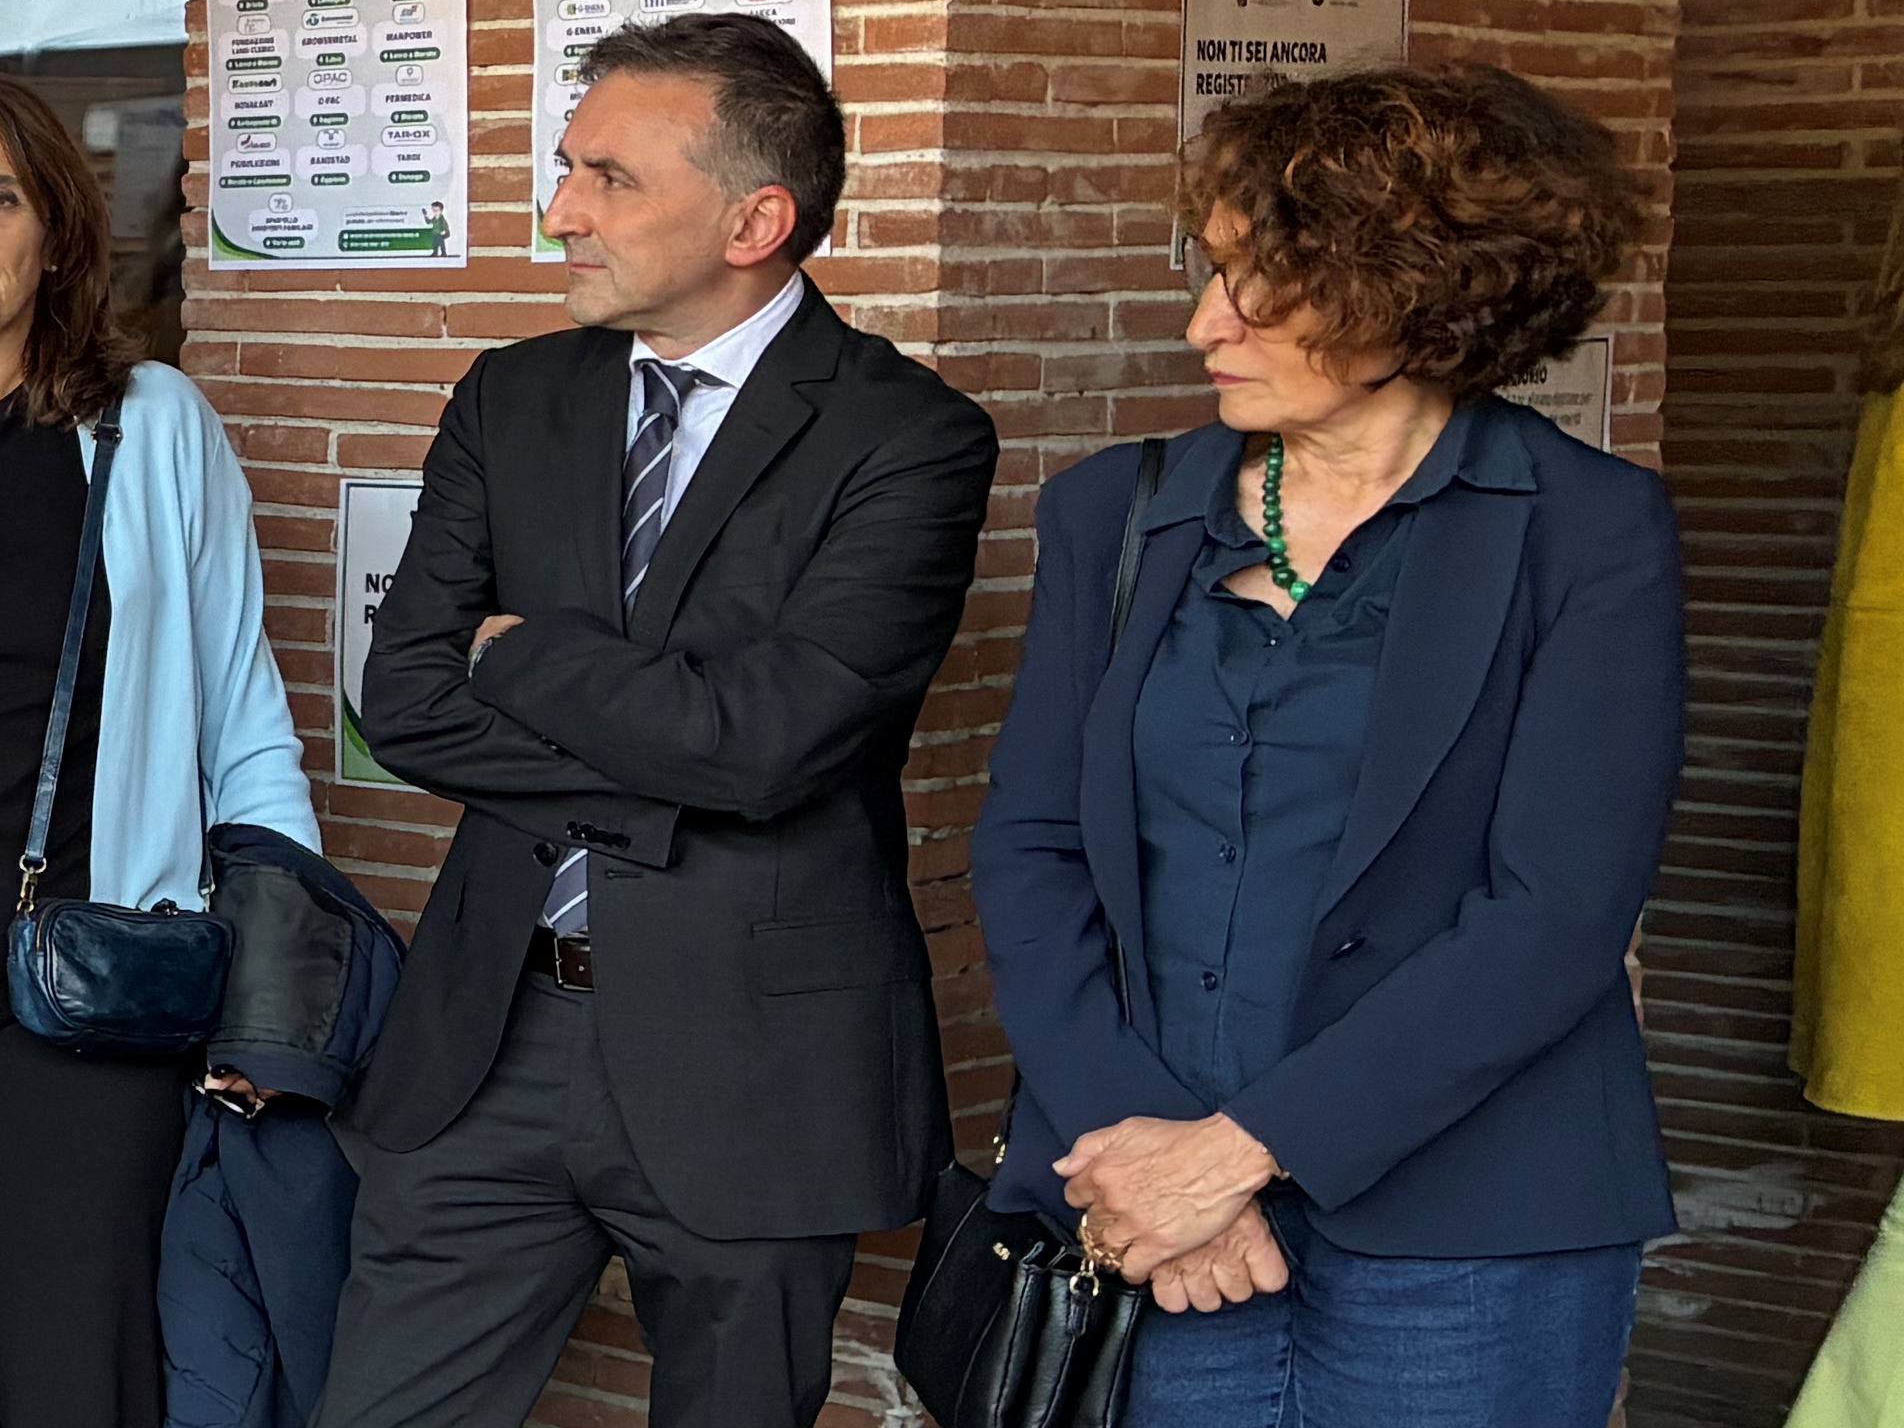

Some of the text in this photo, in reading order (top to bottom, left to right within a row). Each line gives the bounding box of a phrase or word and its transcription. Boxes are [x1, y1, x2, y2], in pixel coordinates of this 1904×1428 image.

[1197, 40, 1327, 63] NON TI SEI ANCORA
